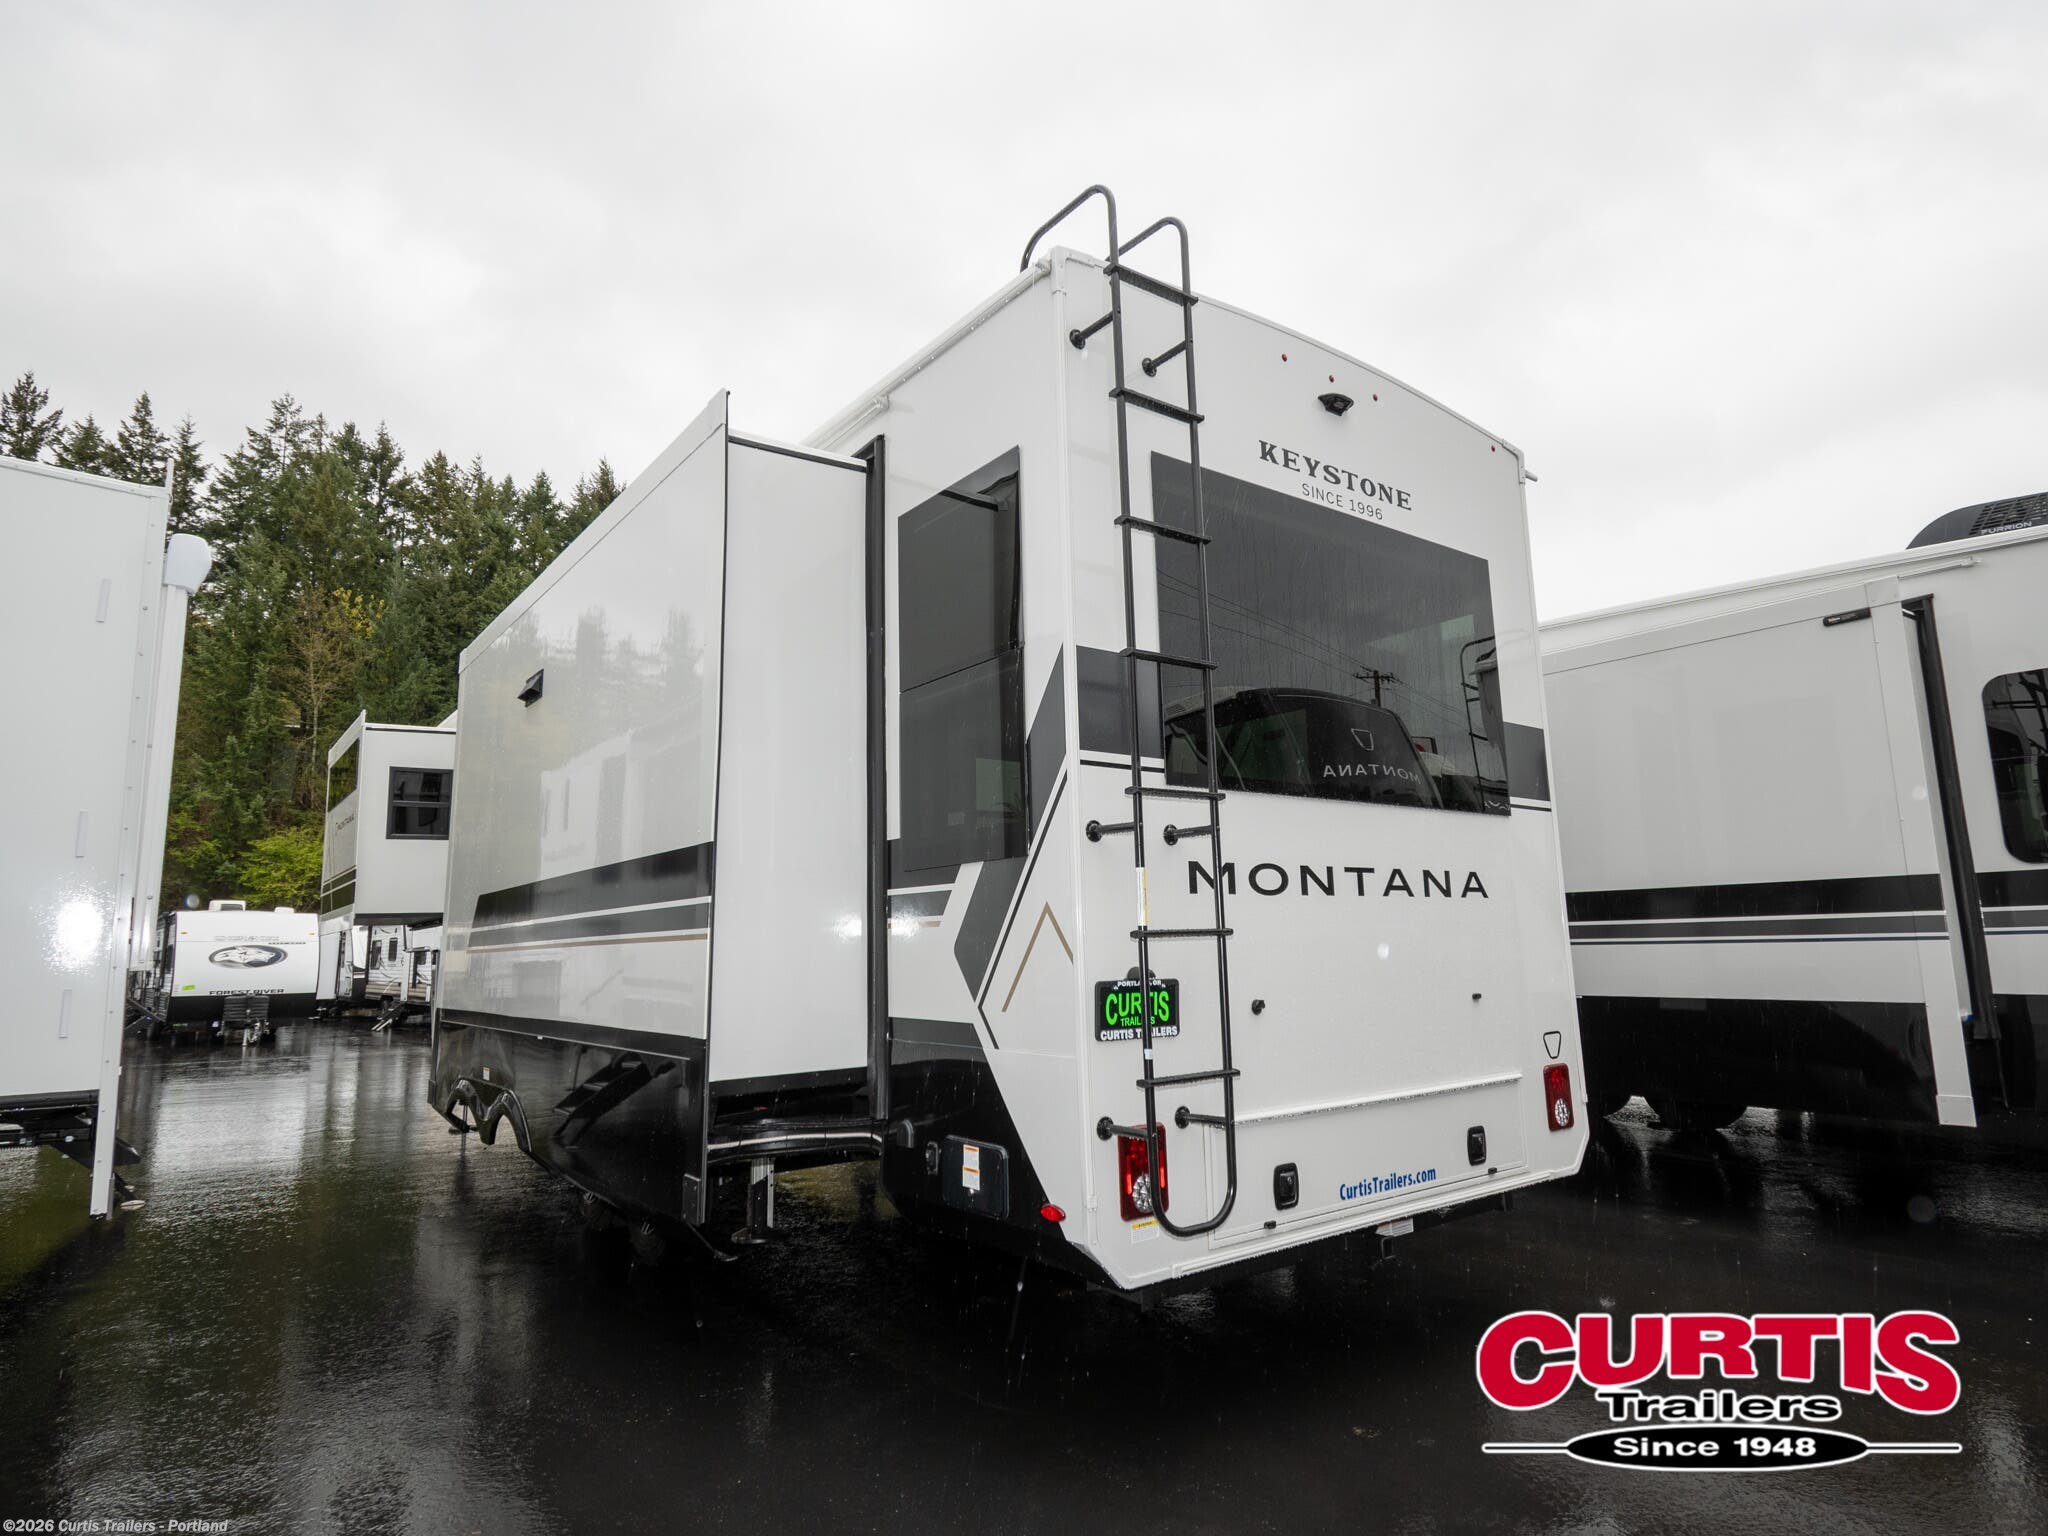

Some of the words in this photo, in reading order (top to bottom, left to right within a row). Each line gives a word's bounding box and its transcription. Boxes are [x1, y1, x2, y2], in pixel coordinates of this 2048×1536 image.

[1258, 440, 1412, 511] KEYSTONE
[1302, 483, 1343, 508] SINCE
[1349, 499, 1383, 521] 1996
[1981, 521, 2032, 536] FURRION
[1188, 861, 1489, 899] MONTANA
[1100, 1029, 1135, 1041] CURTIS
[1136, 1026, 1178, 1038] TILERS
[1120, 1016, 1156, 1027] TRAILS
[1340, 1168, 1436, 1201] CurtisTrailers.com
